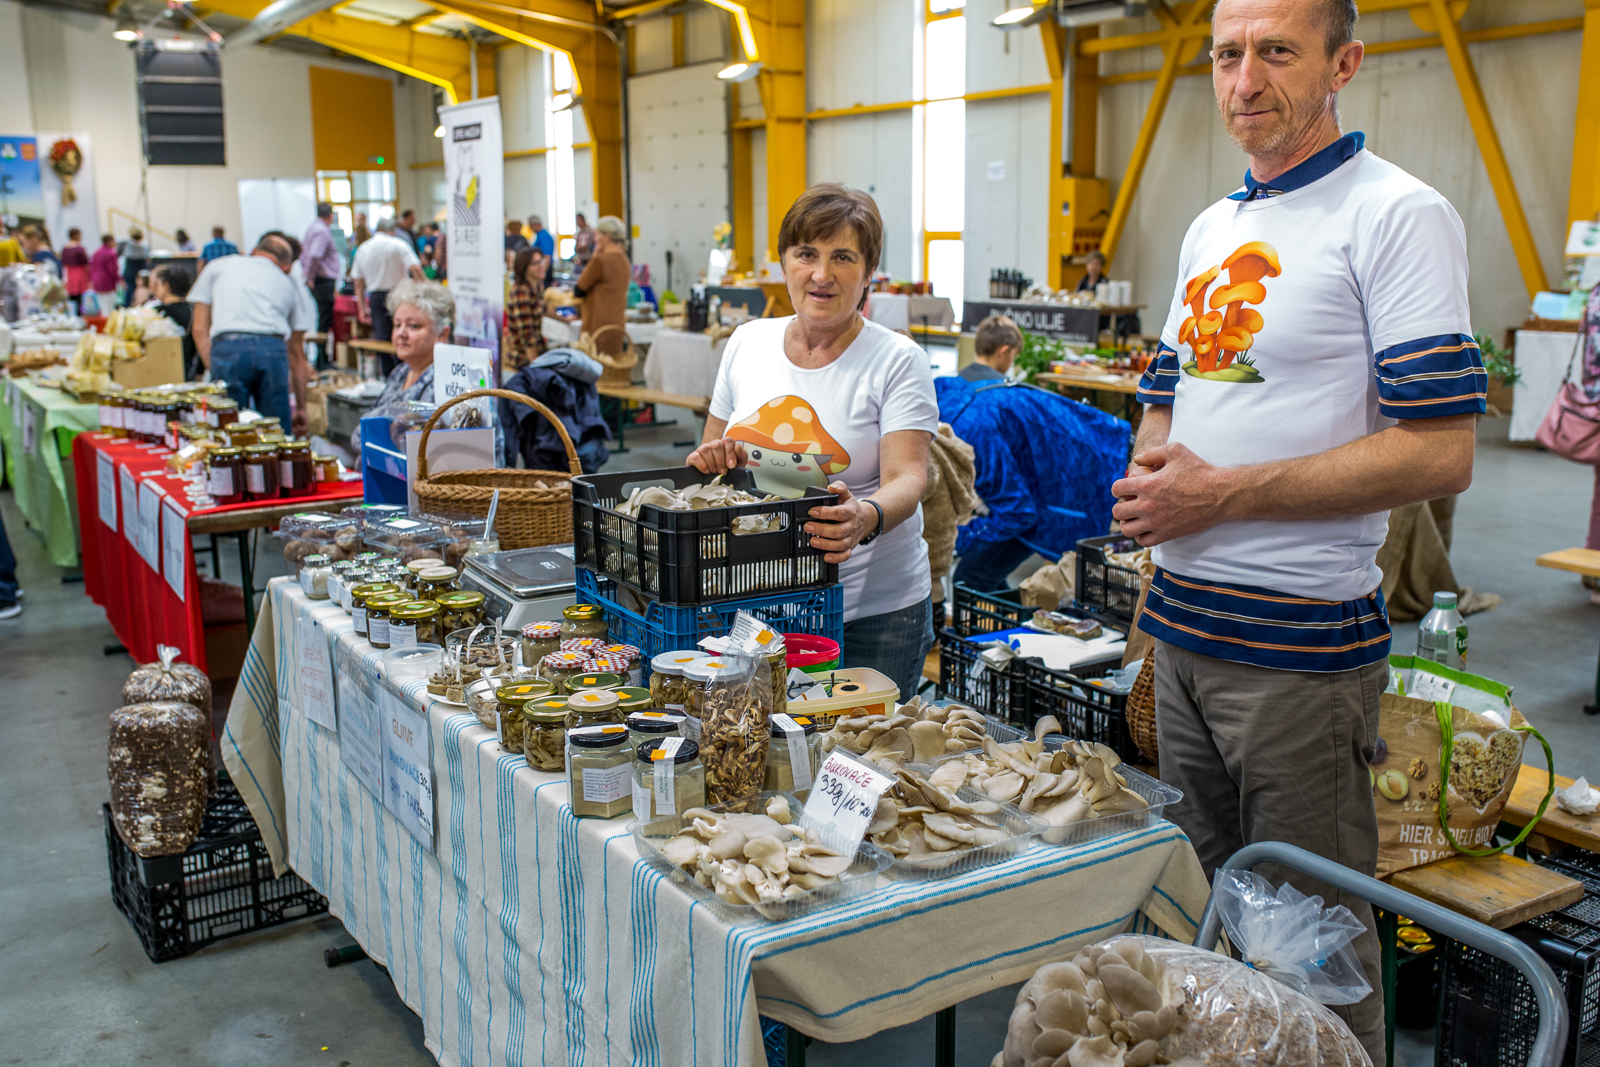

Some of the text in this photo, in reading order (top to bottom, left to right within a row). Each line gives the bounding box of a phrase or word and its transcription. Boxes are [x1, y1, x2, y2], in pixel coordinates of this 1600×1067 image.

[451, 363, 466, 377] OPG
[824, 757, 874, 788] BUKOVAČE
[1399, 824, 1434, 845] HIER
[1474, 825, 1490, 845] BIO
